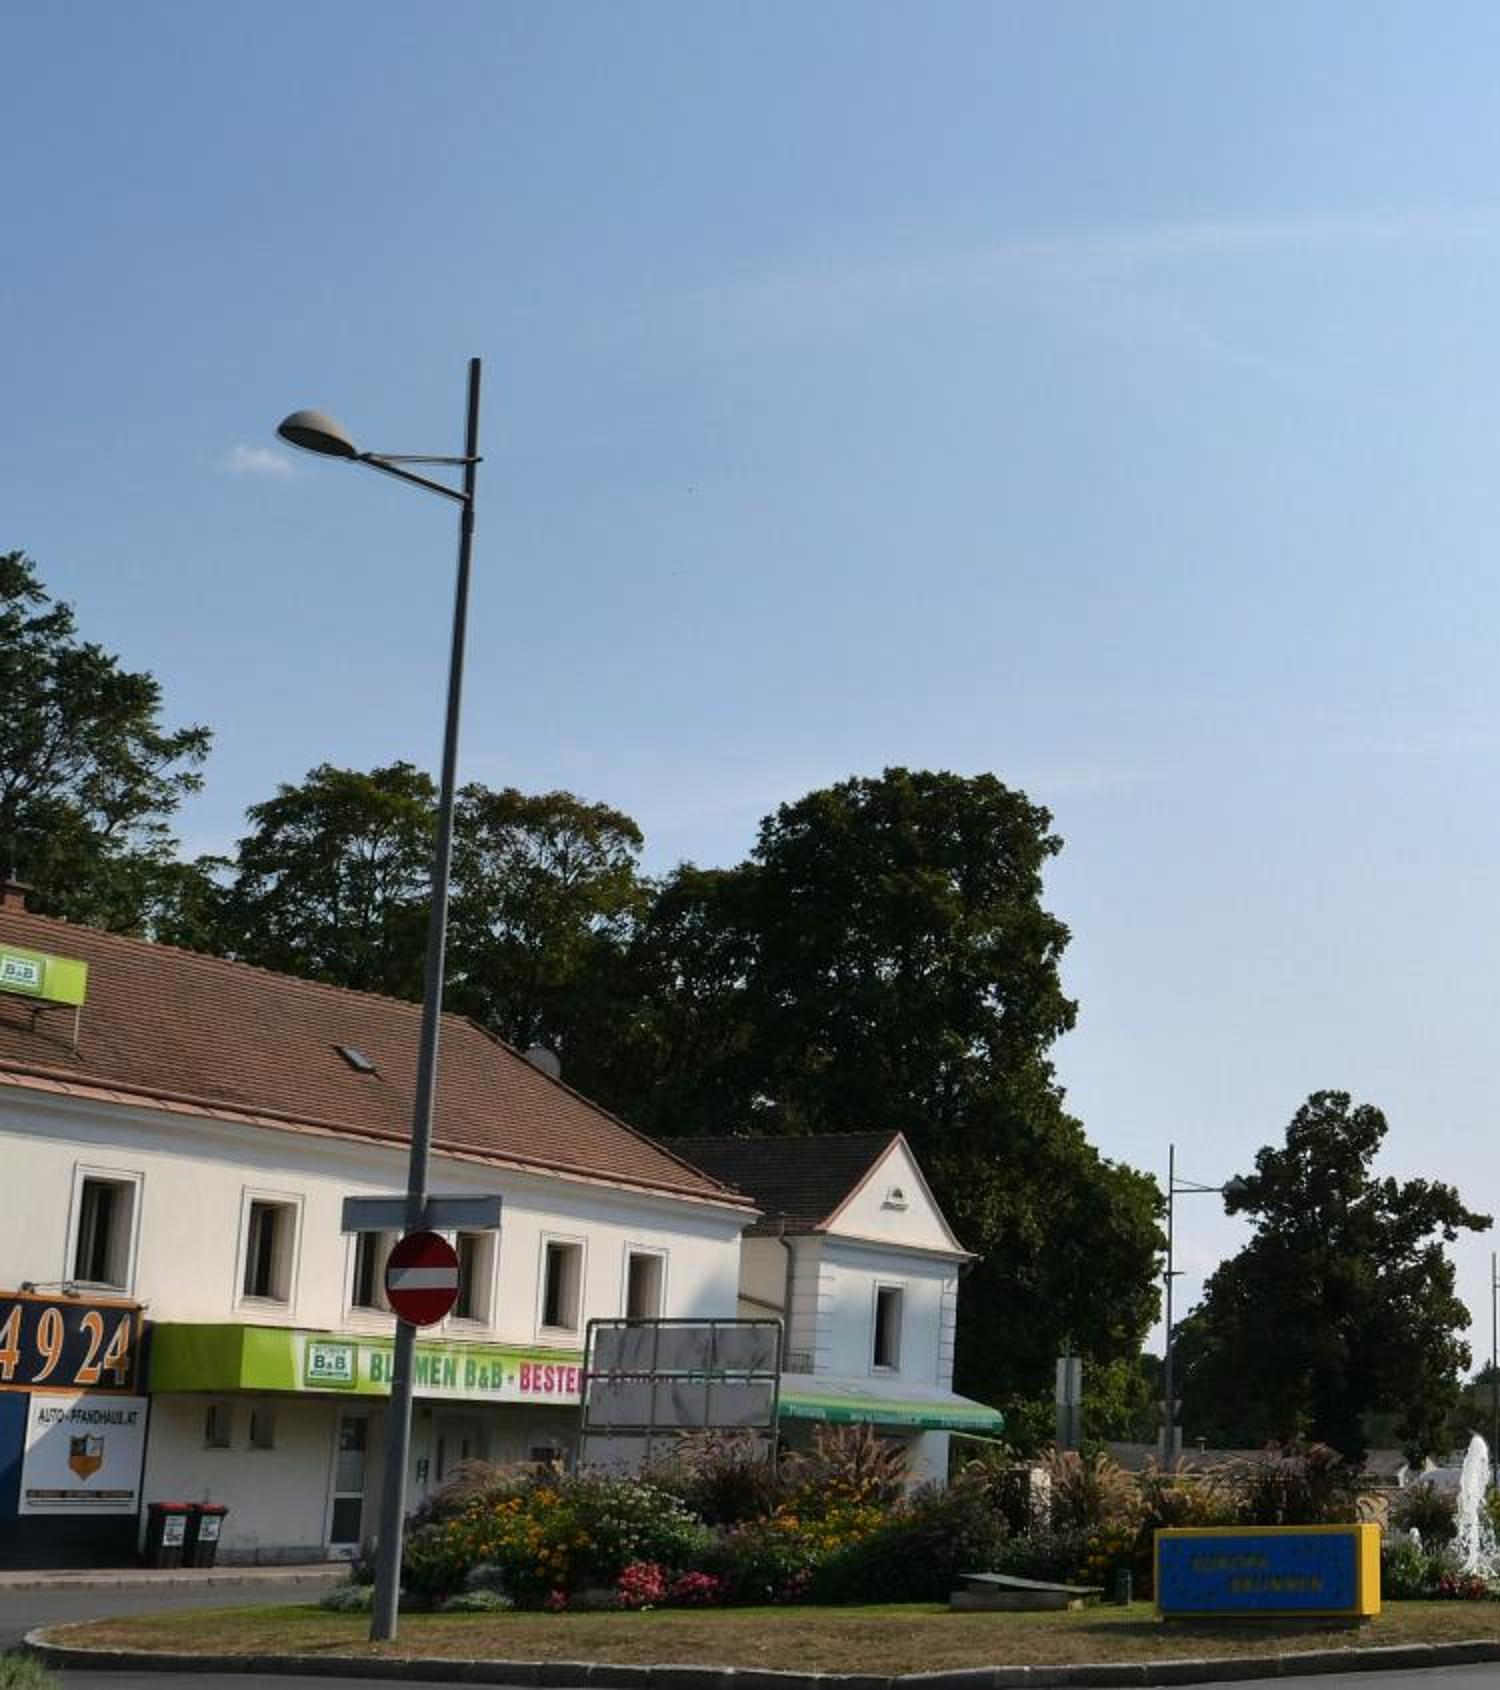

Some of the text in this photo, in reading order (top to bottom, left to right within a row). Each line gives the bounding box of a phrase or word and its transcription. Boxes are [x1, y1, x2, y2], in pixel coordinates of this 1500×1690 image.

[313, 1355, 346, 1370] B&B
[369, 1353, 457, 1386] BLMEN
[464, 1359, 503, 1389] B&B
